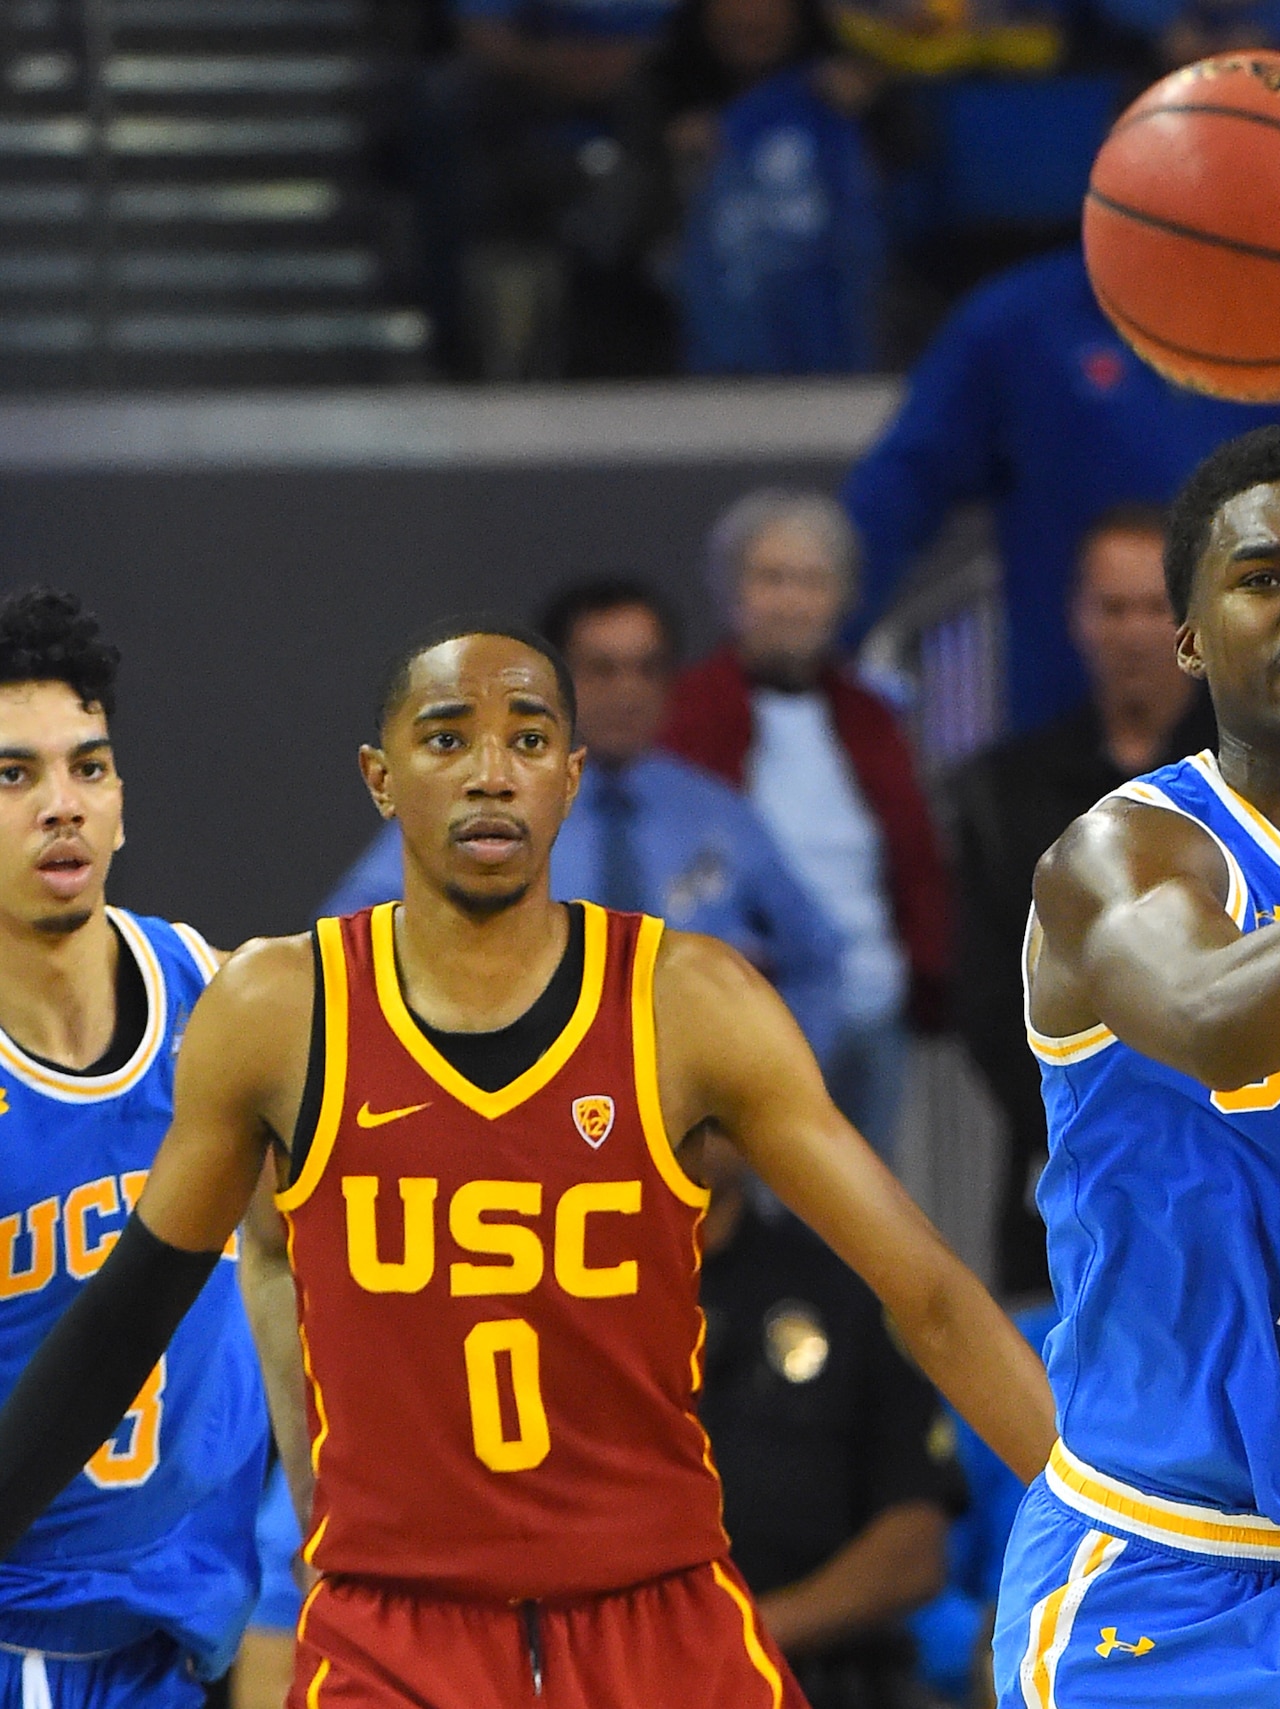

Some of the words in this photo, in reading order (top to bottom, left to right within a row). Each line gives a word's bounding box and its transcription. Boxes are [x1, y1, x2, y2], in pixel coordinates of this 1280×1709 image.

[0, 1169, 239, 1300] UC
[341, 1172, 643, 1299] USC
[463, 1317, 552, 1473] 0
